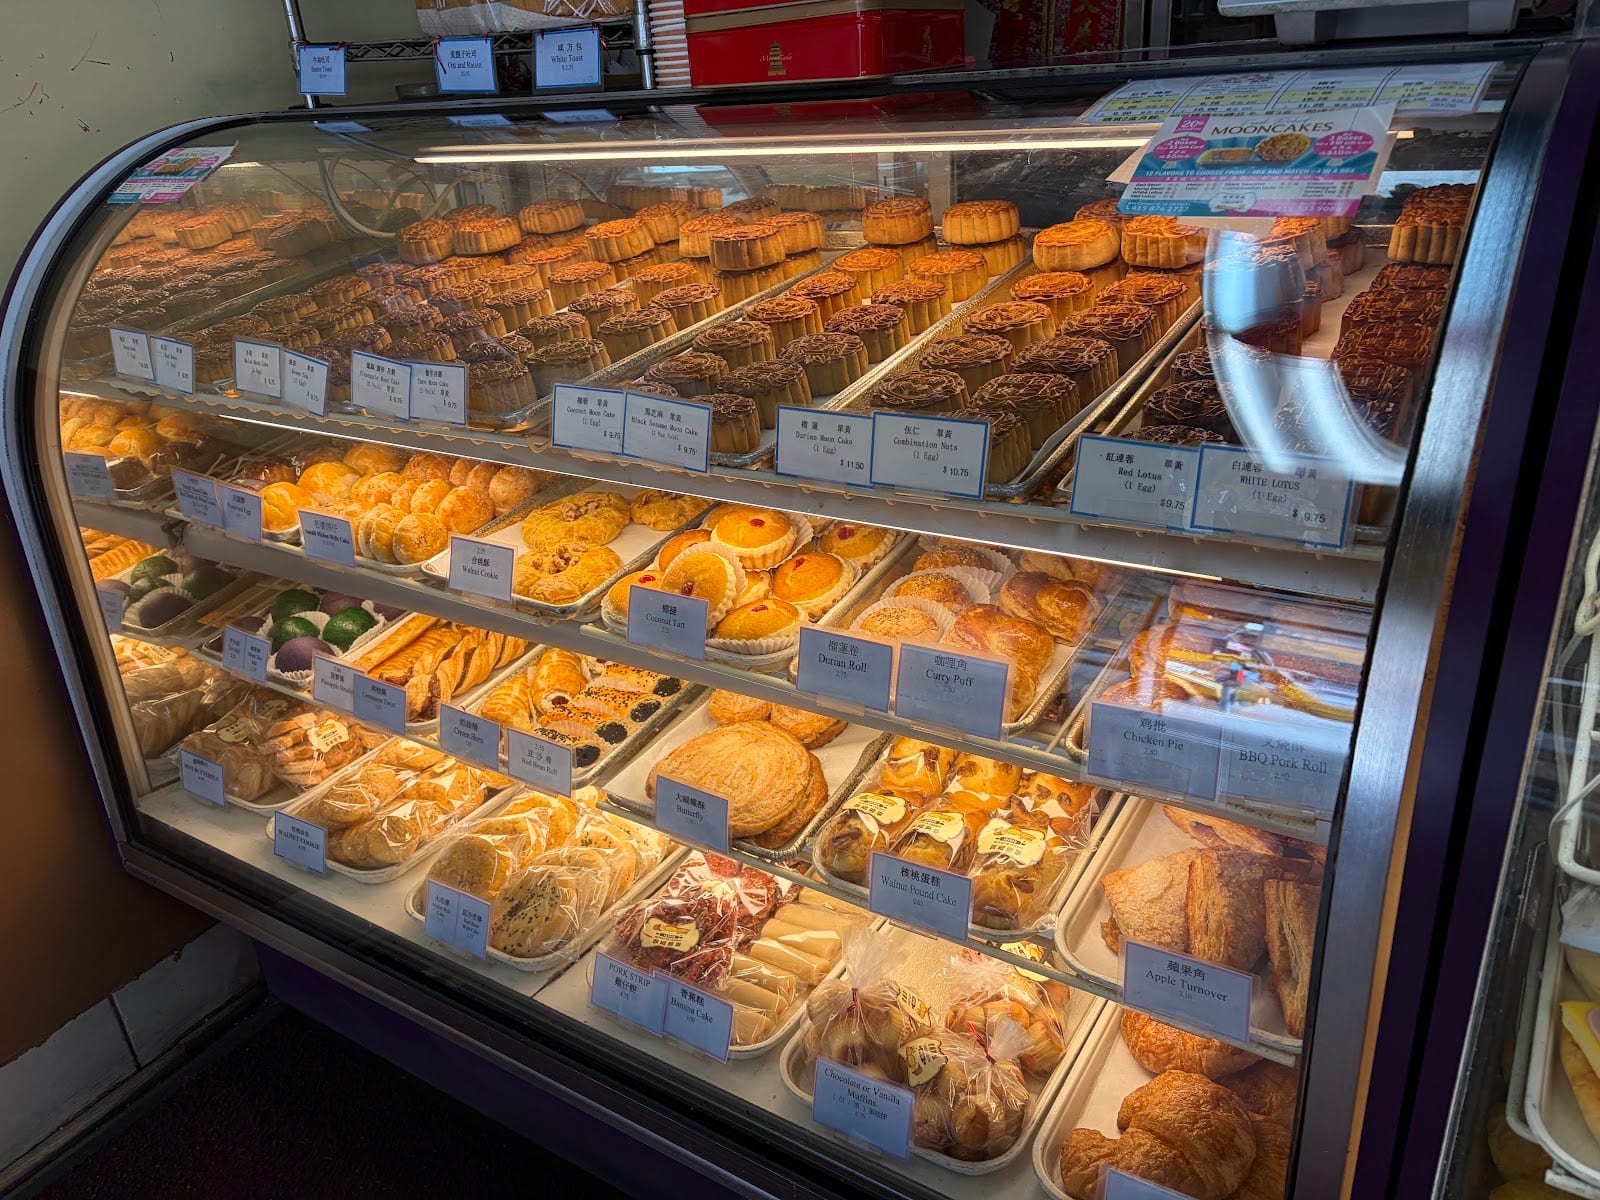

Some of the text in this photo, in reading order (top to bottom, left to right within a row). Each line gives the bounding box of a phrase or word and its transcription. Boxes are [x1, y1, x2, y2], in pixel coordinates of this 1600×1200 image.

[551, 54, 584, 63] White Toast
[1211, 122, 1334, 135] MOONCAKES
[566, 406, 587, 415] Coconut
[602, 410, 616, 419] Cake
[631, 416, 646, 425] Black
[669, 424, 683, 432] Moon
[684, 426, 698, 436] Cake
[608, 431, 621, 439] 9.75
[795, 431, 853, 445] Durian Moon Cake
[683, 446, 697, 455] 9.75
[822, 445, 837, 455] Egg)
[893, 436, 958, 451] Combination Nuts
[923, 450, 939, 462] Egg)
[846, 460, 865, 470] 11.50
[949, 467, 969, 477] 10.75
[1117, 467, 1162, 480] Red Lotus
[1136, 482, 1156, 494] Egg)
[1239, 475, 1300, 490] WHITE LOTUS
[1266, 492, 1287, 504] Egg)
[1292, 508, 1326, 524] $ 9.75
[462, 565, 499, 580] Walnut Cookie
[645, 613, 686, 629] Coconut Tart
[818, 653, 867, 673] Durian Roll
[925, 669, 975, 687] Curry Puff
[453, 726, 484, 744] Cream Horn
[1123, 730, 1184, 751] Chicken Pie
[521, 757, 558, 776] Red Bean Roll
[1239, 749, 1328, 774] BBQ Pork Roll
[676, 804, 704, 822] Butterfly
[880, 874, 957, 908] Walnut Pound Cake
[609, 962, 651, 987] PORK STRIP
[1145, 969, 1228, 1001] Apple Turnover
[671, 997, 713, 1023] Banana Cake
[824, 1067, 901, 1106] Chocolate or Vanilla
[847, 1088, 877, 1108] Muffins
